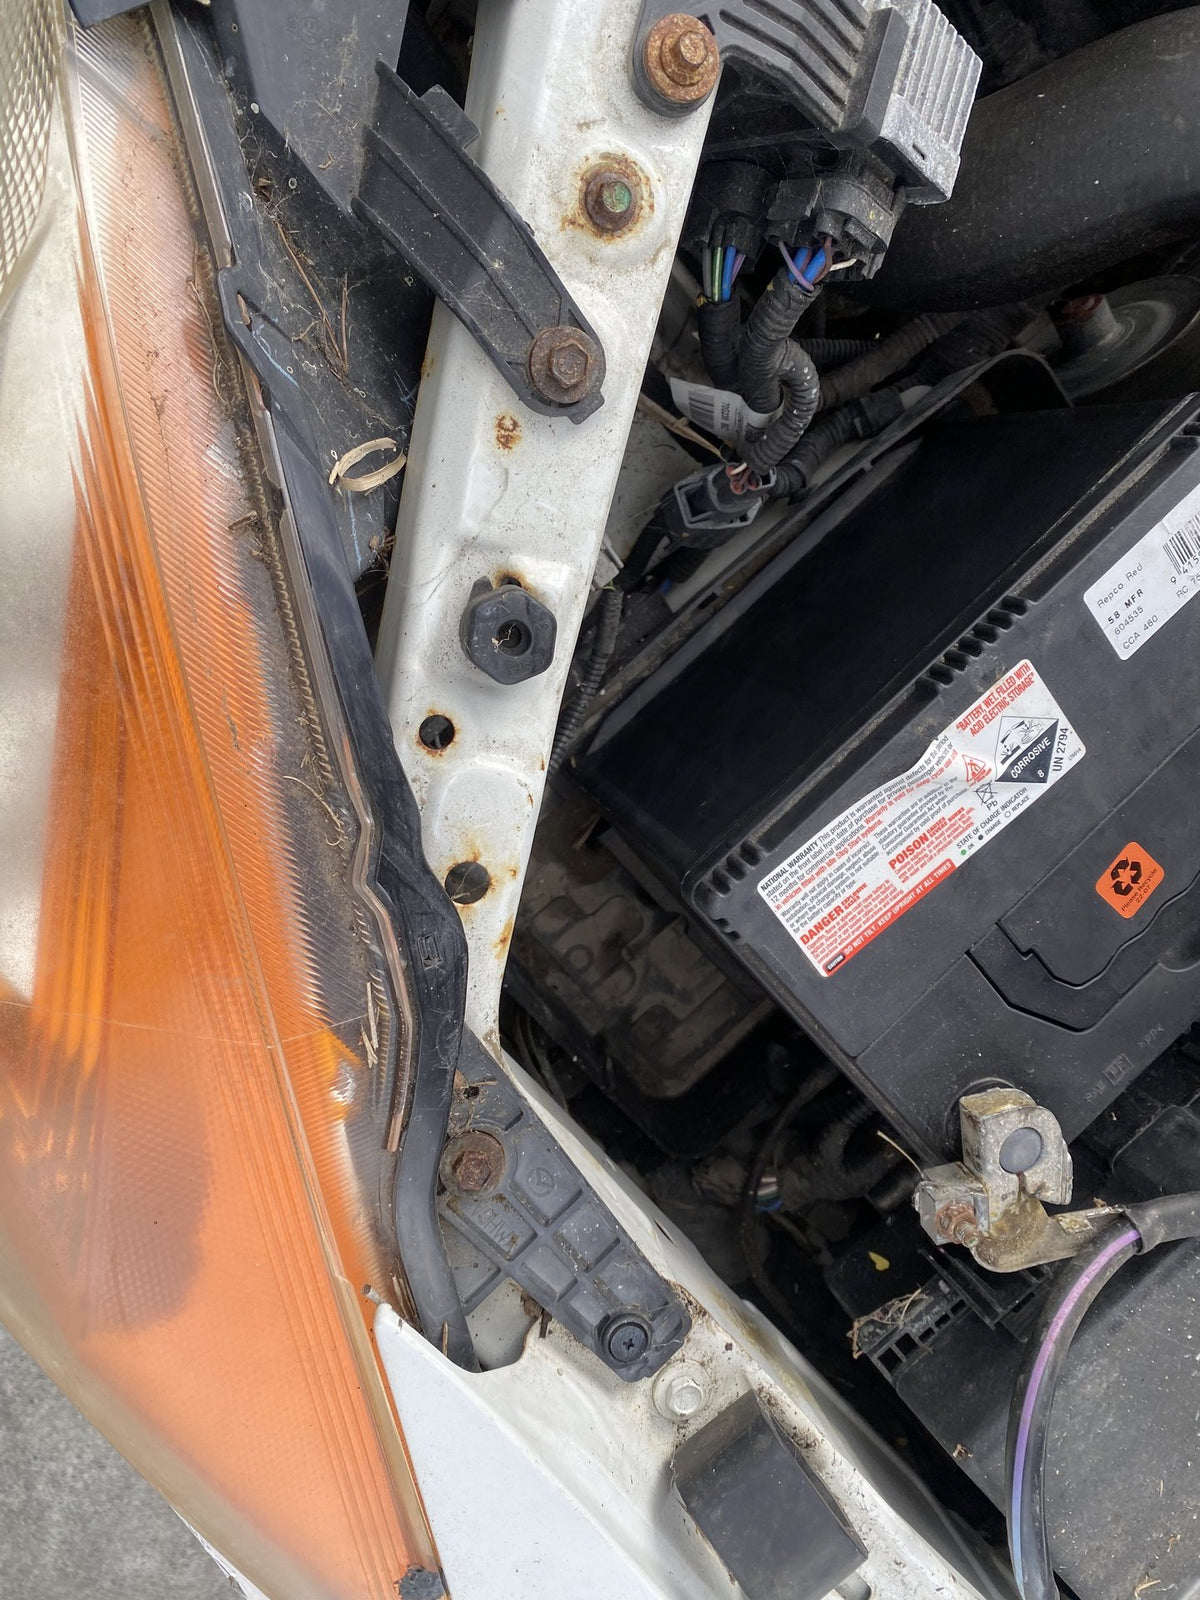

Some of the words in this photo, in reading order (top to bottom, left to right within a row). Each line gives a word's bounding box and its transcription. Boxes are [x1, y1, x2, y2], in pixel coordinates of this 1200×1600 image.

[1097, 583, 1124, 608] Repco
[1125, 563, 1143, 582] Red
[1176, 585, 1189, 599] RC
[1107, 610, 1121, 624] 58
[1124, 589, 1144, 609] MFR
[1114, 606, 1144, 635] 604535
[1123, 631, 1141, 650] CCA
[1142, 614, 1159, 631] 460
[996, 676, 1017, 697] FILLED
[1014, 663, 1031, 681] WITH
[969, 719, 985, 736] ACID
[982, 698, 1010, 724] ELECTRIC
[1010, 737, 1051, 779] CORROSIVE
[1056, 727, 1069, 754] 2794
[1037, 769, 1045, 778] 8
[1052, 756, 1064, 772] UN
[957, 833, 973, 848] STATE
[972, 827, 980, 835] OF
[980, 809, 1001, 829] CHARGE
[1000, 787, 1028, 811] INDICATOR
[985, 820, 1001, 835] CHARGE
[1011, 795, 1030, 812] REPLACE
[986, 799, 998, 810] Pb
[761, 866, 788, 891] NATIONAL
[787, 841, 819, 869] WARRANTY
[818, 832, 830, 842] This
[831, 816, 850, 834] product
[856, 791, 883, 813] warranted
[883, 778, 905, 793] against
[905, 765, 926, 780] defects
[767, 883, 782, 898] stated
[789, 870, 799, 878] the
[798, 858, 811, 870] front
[811, 847, 823, 860] label
[823, 838, 836, 849] from
[836, 828, 848, 839] date
[855, 804, 878, 825] purchase
[887, 785, 906, 799] private
[907, 766, 935, 787] passenger
[771, 895, 779, 903] 12
[779, 881, 798, 897] months
[806, 849, 834, 875] commercial
[835, 824, 866, 850] applications.
[864, 805, 889, 825] Warranty
[894, 792, 905, 801] void
[915, 778, 931, 788] deep
[931, 767, 944, 779] cycle
[944, 759, 952, 768] use
[781, 887, 802, 905] vehicles
[801, 875, 815, 888] fitted
[815, 865, 826, 877] with
[826, 858, 836, 866] Idle
[836, 848, 849, 859] Stop
[848, 836, 861, 848] Start
[862, 820, 883, 838] systems.
[888, 833, 929, 870] POISON
[844, 945, 853, 954] DO
[853, 936, 864, 947] NOT
[865, 924, 879, 937] TILT,
[878, 912, 893, 926] KEEP
[892, 892, 916, 914] UPRIGHT
[915, 885, 923, 894] AT
[923, 877, 934, 887] ALL
[934, 862, 952, 878] TIMES
[1122, 892, 1138, 912] Please
[1138, 869, 1158, 891] Recycle
[800, 905, 844, 945] DANGER
